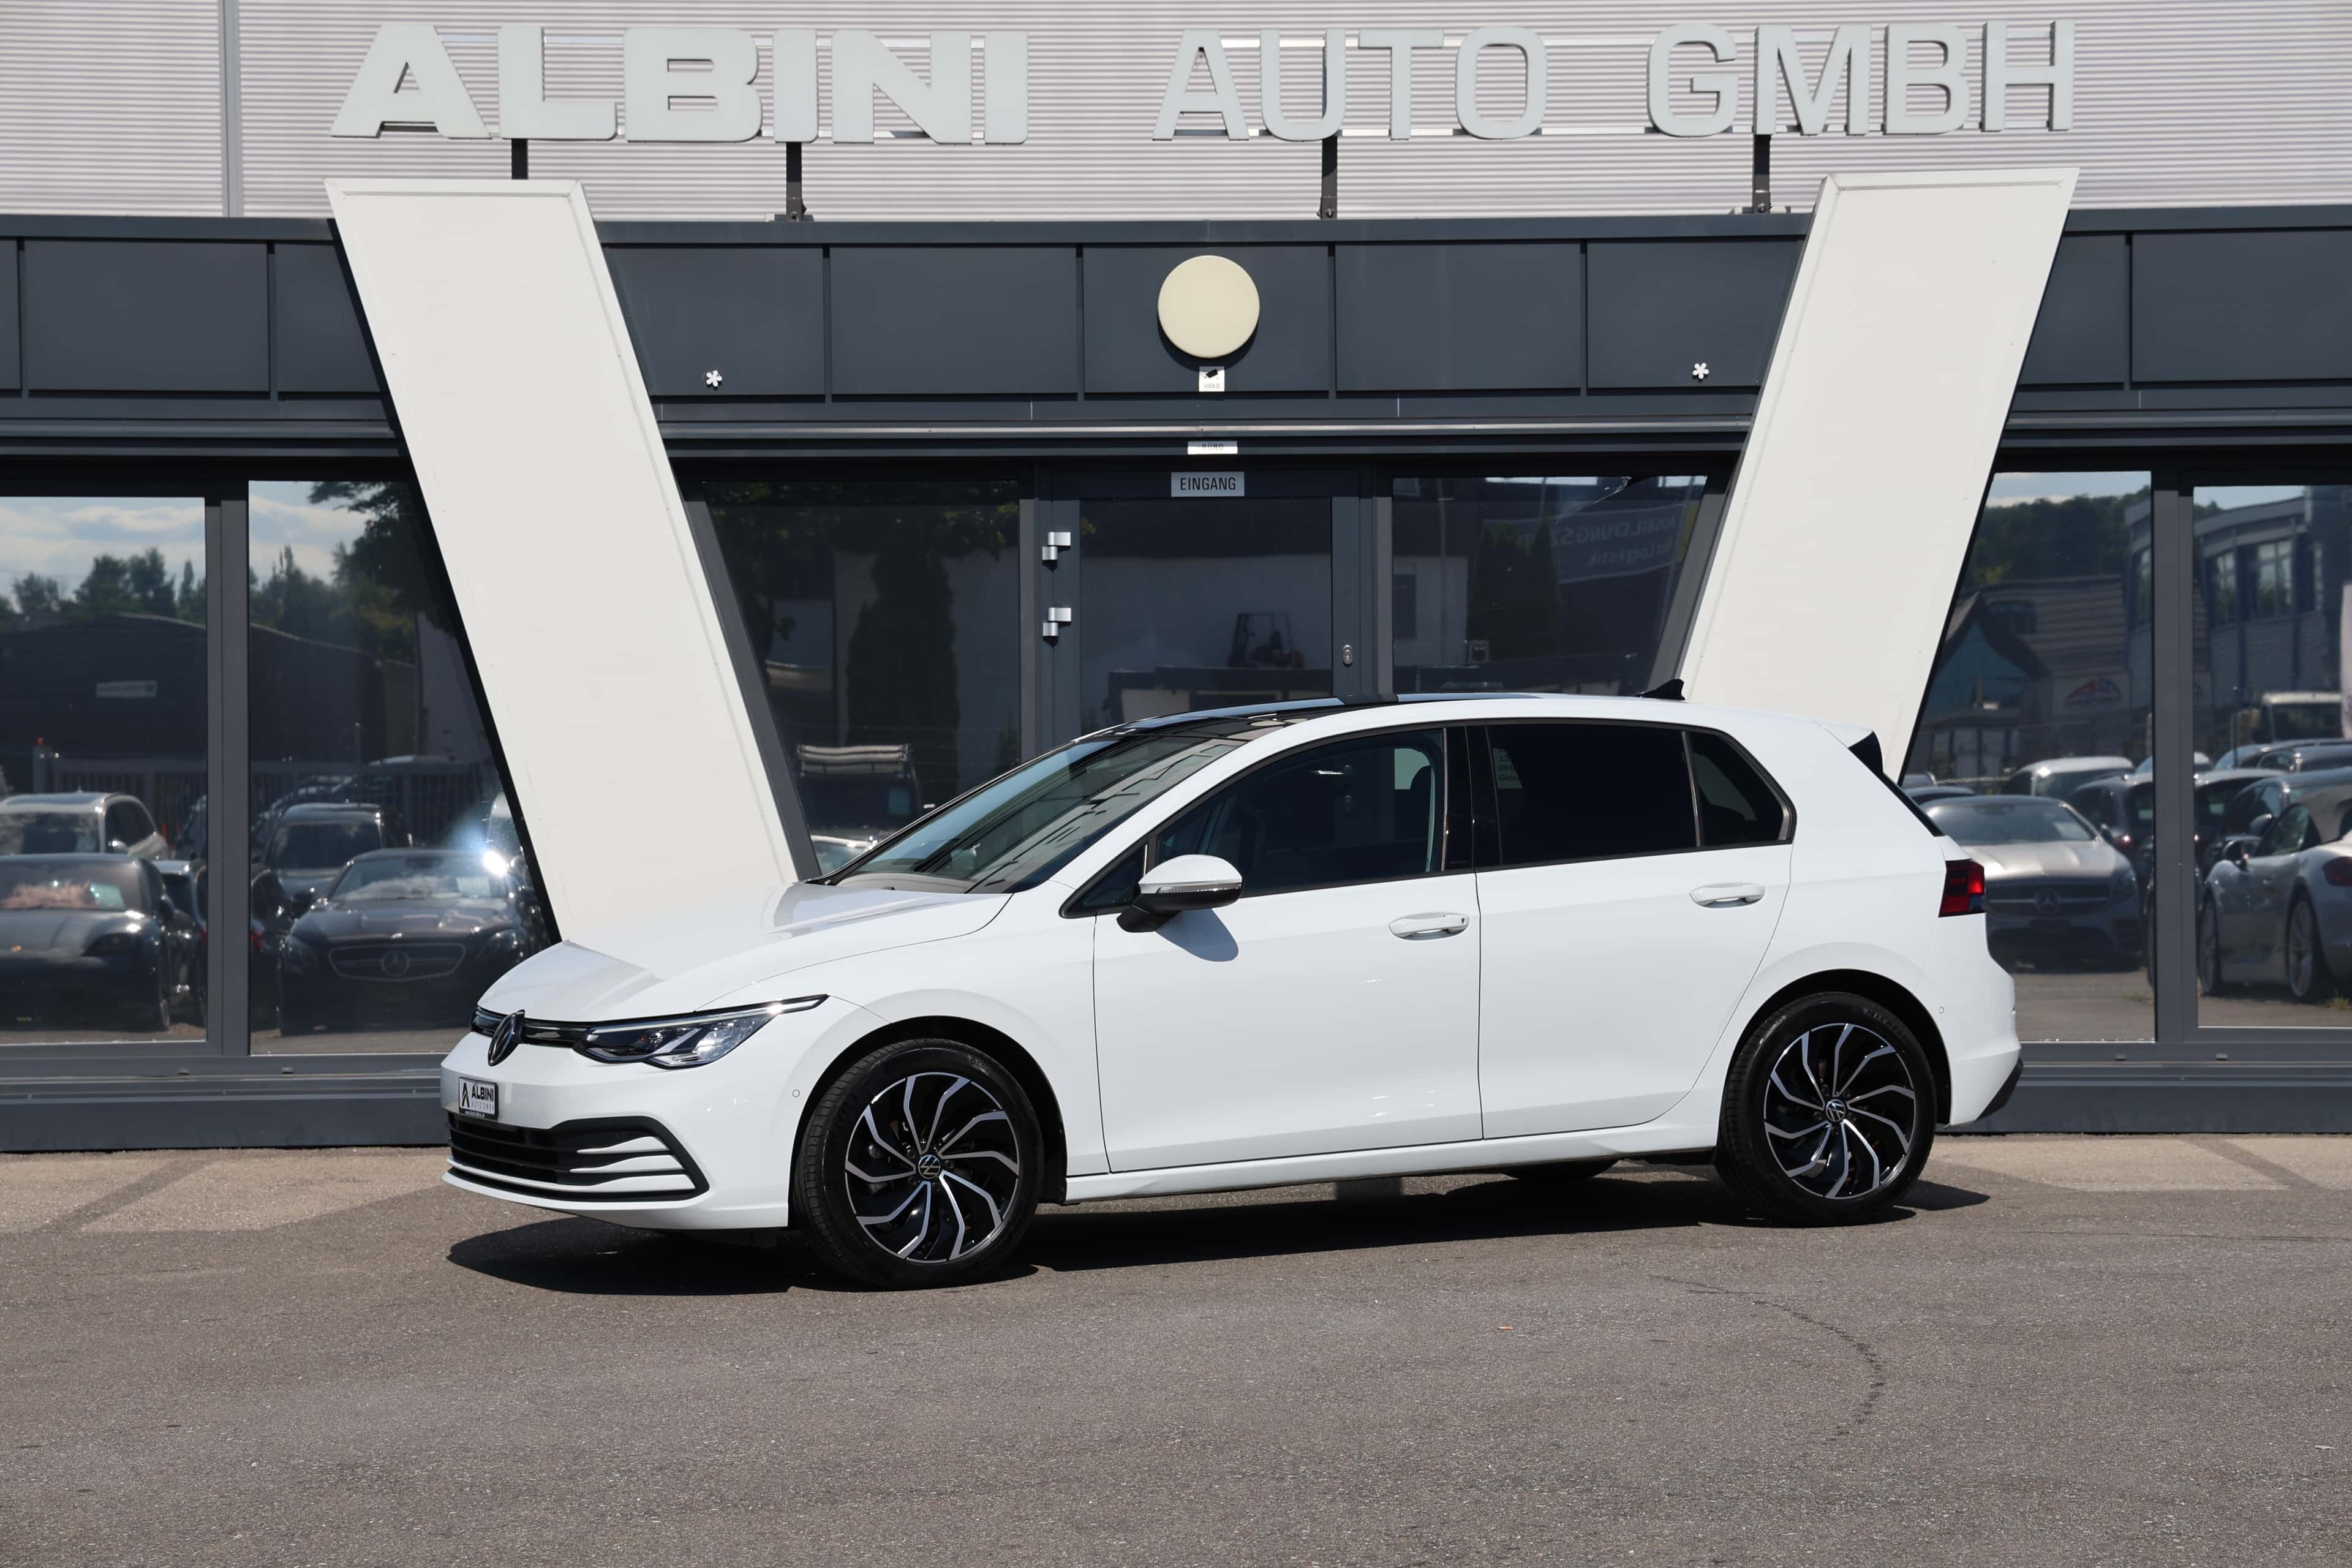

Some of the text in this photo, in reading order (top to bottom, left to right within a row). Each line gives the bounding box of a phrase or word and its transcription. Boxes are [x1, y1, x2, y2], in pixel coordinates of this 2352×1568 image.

[329, 20, 2075, 145] ALBINI AUTO GMBH
[1202, 442, 1223, 451] BÜRO
[1180, 477, 1236, 491] EINGANG
[472, 1085, 494, 1102] ALBINI
